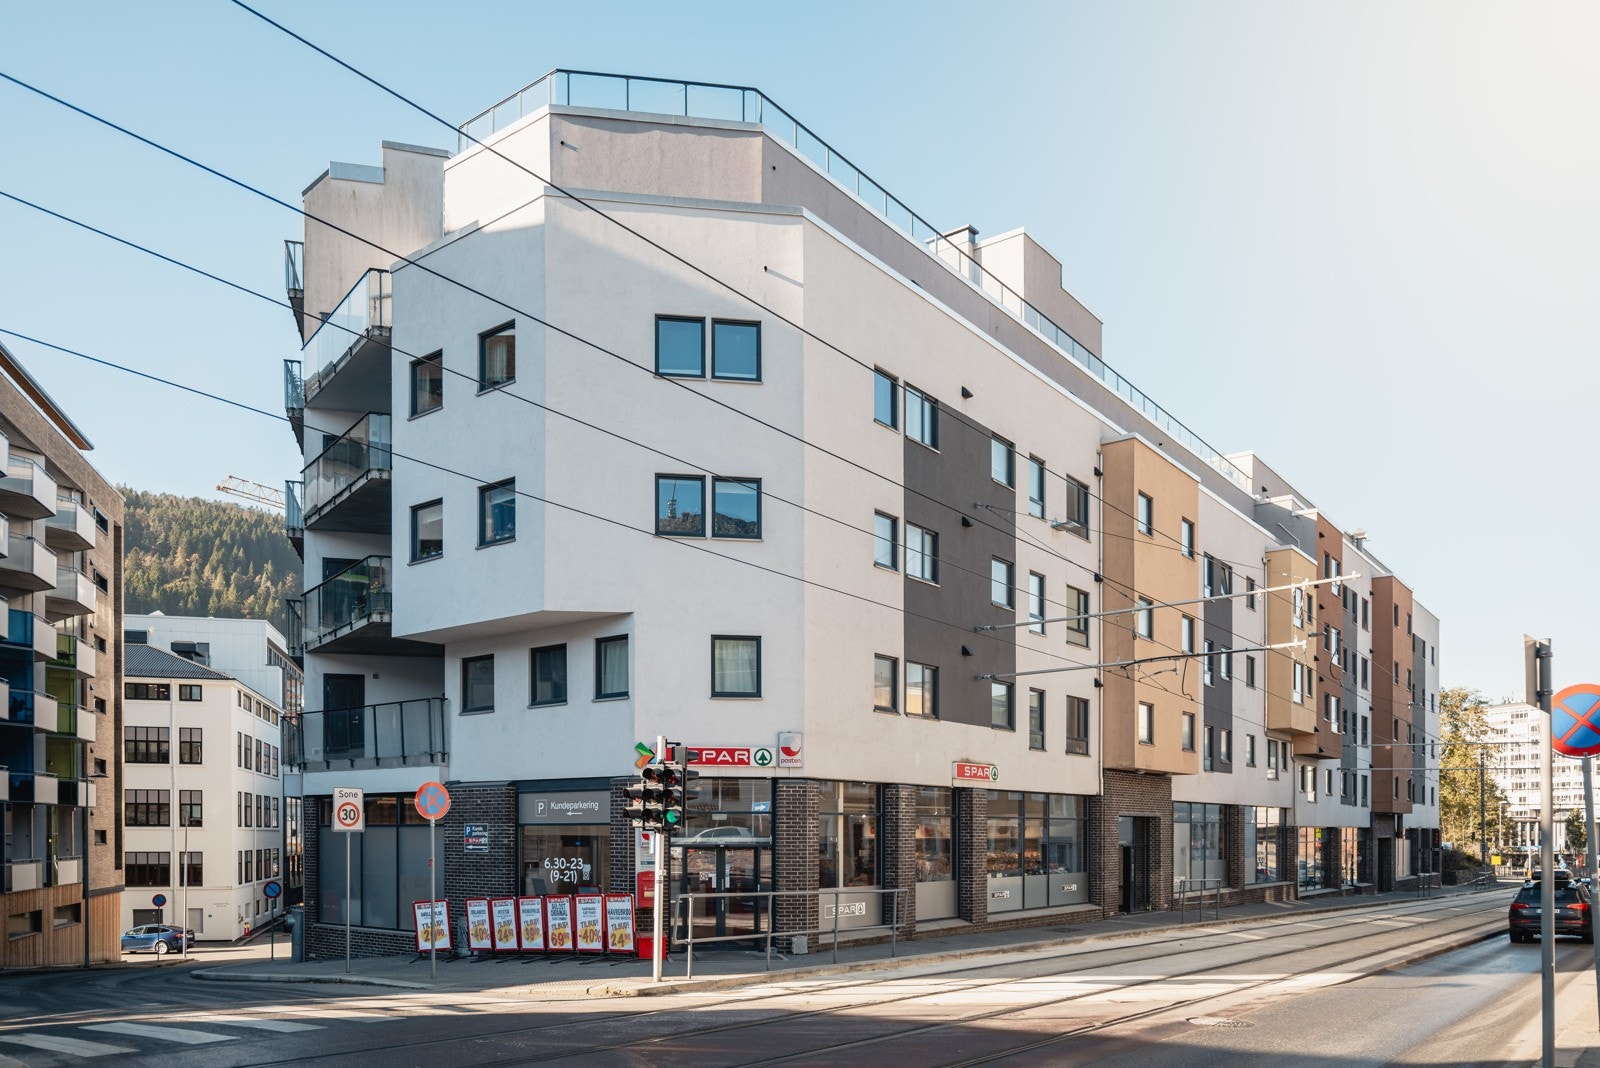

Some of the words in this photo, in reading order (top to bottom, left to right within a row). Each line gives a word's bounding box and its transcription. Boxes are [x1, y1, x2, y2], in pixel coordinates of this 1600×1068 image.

[780, 757, 801, 765] posten
[964, 766, 990, 777] SPAR
[338, 790, 359, 798] Sone
[550, 801, 599, 811] Kundeparkering
[341, 808, 356, 821] 30
[544, 857, 584, 869] 6.30-23
[550, 870, 578, 884] (9-21)
[579, 929, 601, 944] -40%
